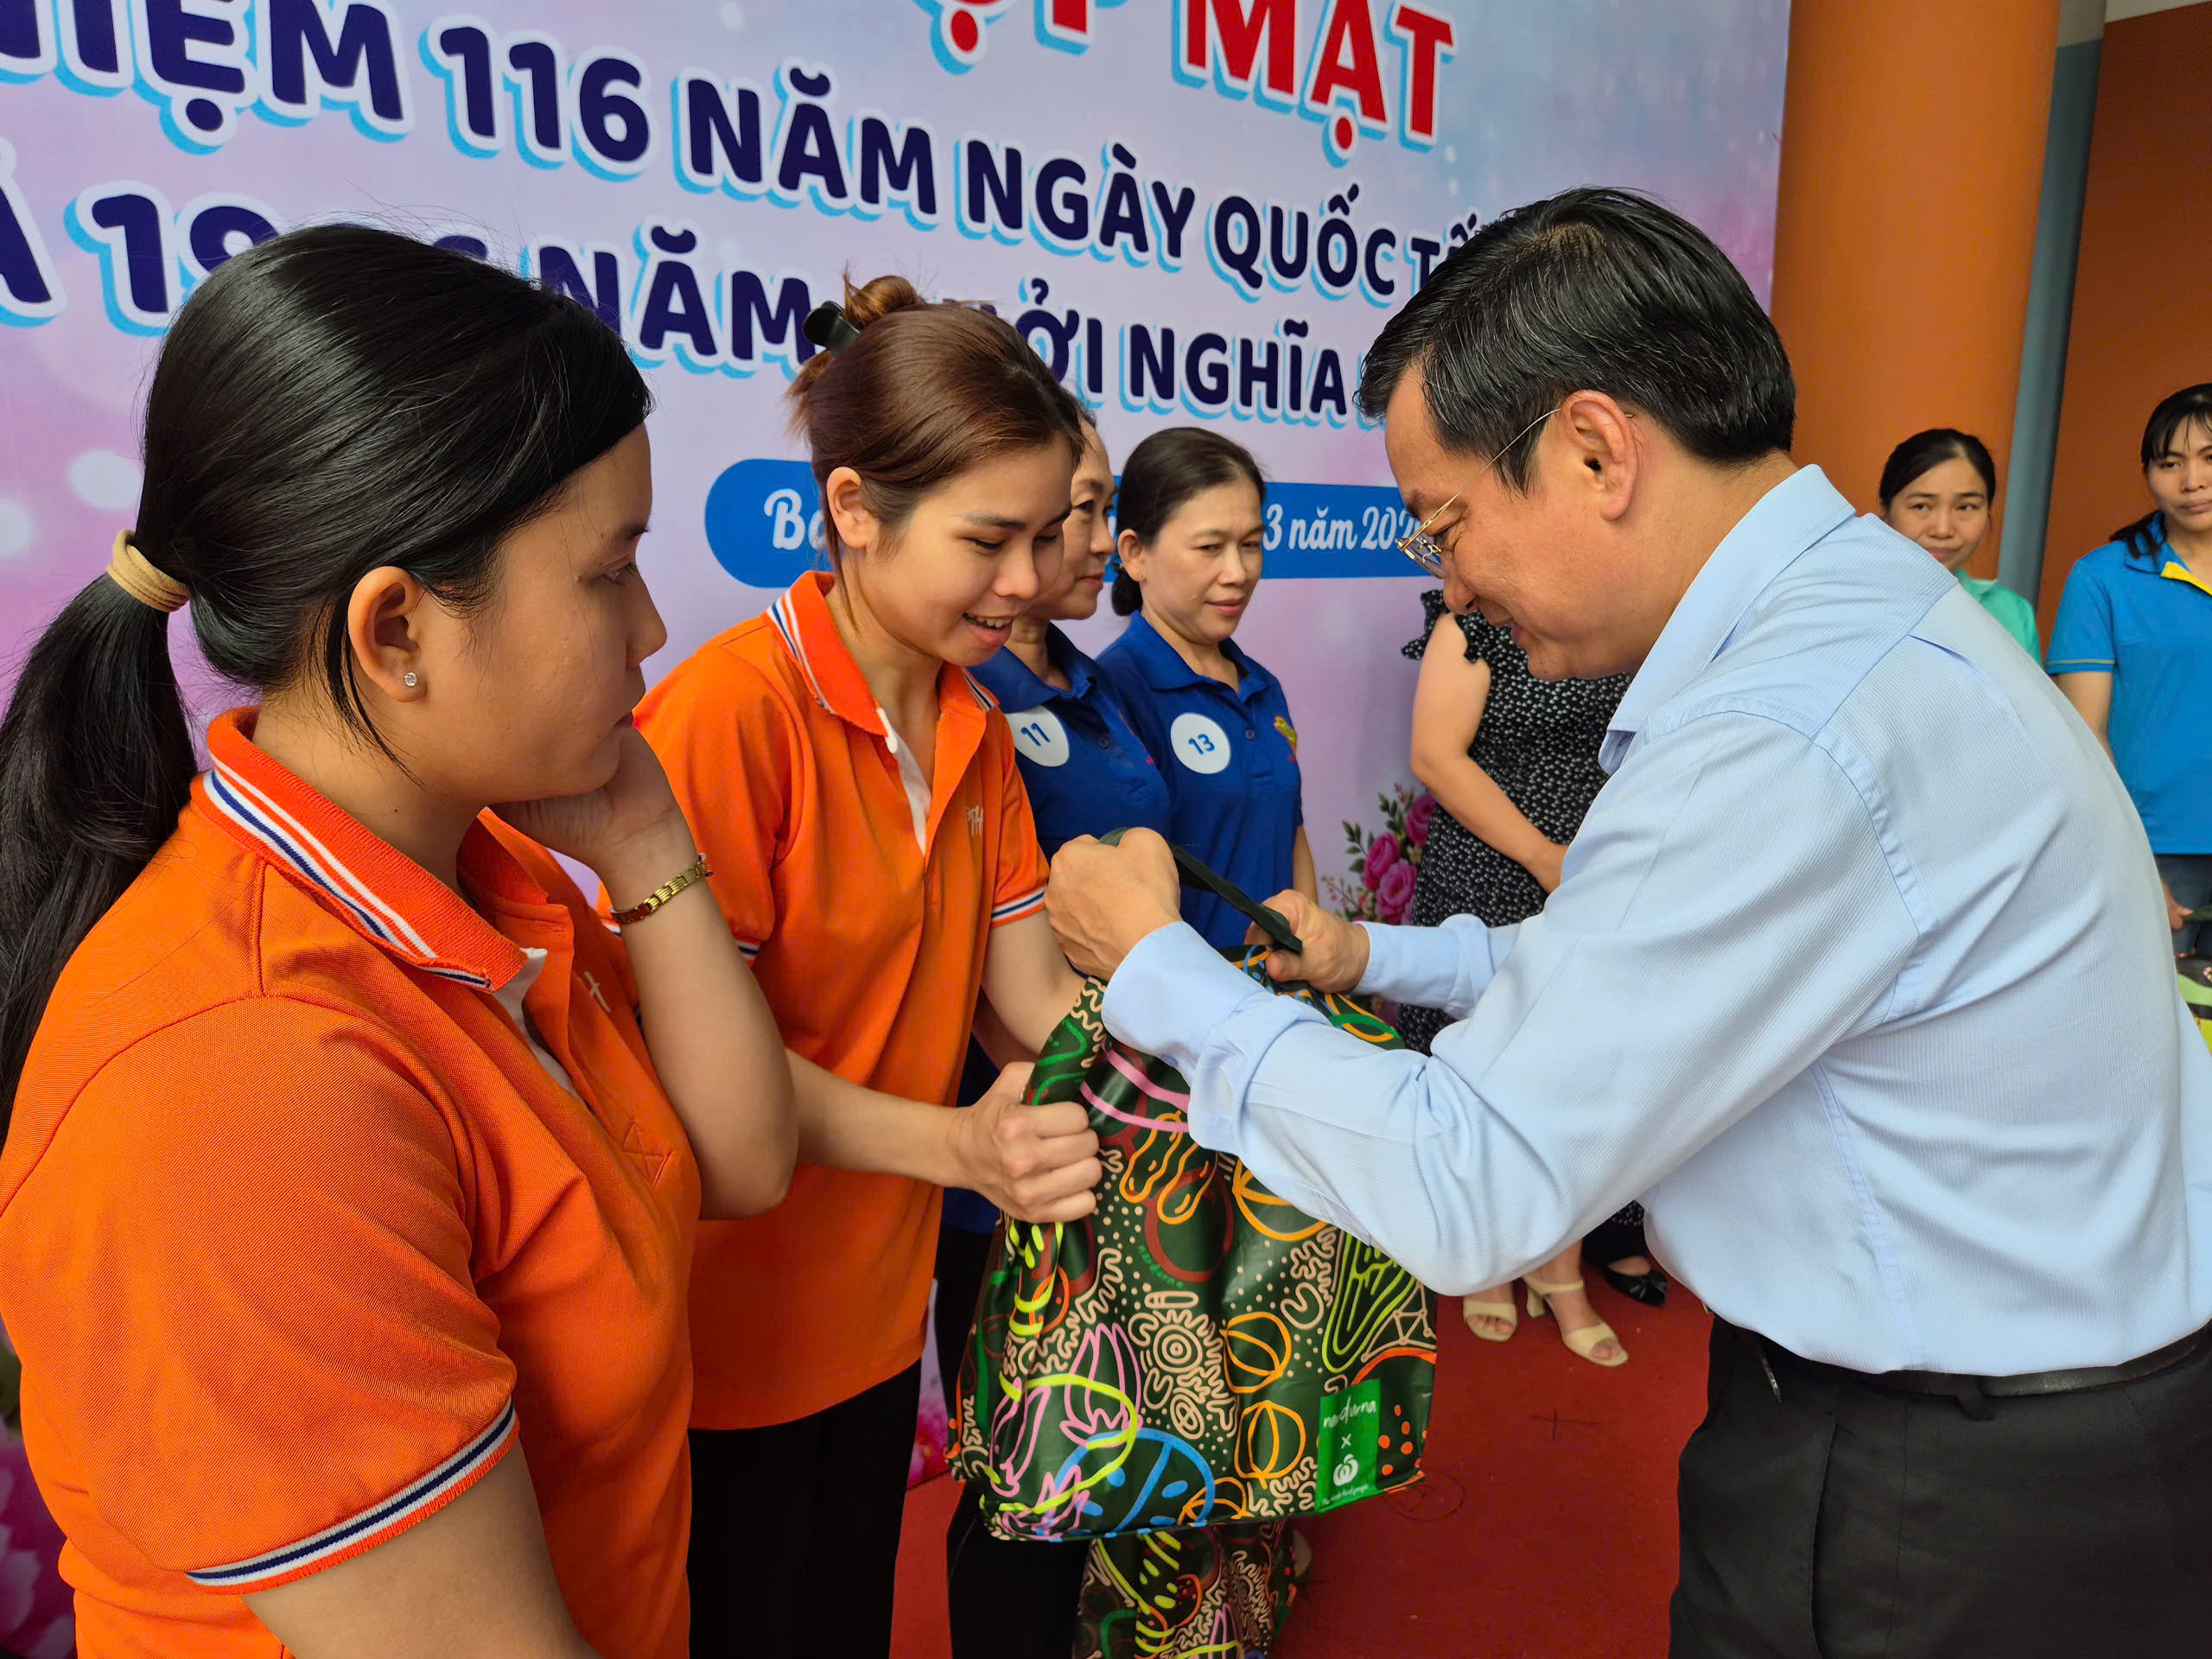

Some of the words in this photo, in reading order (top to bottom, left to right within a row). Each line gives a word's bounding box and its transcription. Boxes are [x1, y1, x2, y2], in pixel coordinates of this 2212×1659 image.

[440, 26, 651, 162] 116
[687, 67, 937, 215] NĂM
[966, 143, 1195, 258] NGÀY
[1215, 183, 1396, 296] QUỐC
[539, 226, 817, 365] NĂM
[1130, 321, 1347, 416] NGHĨA
[1288, 506, 1357, 550] năm
[1361, 506, 1422, 550] 202
[1020, 722, 1051, 747] 11
[1188, 734, 1216, 755] 13
